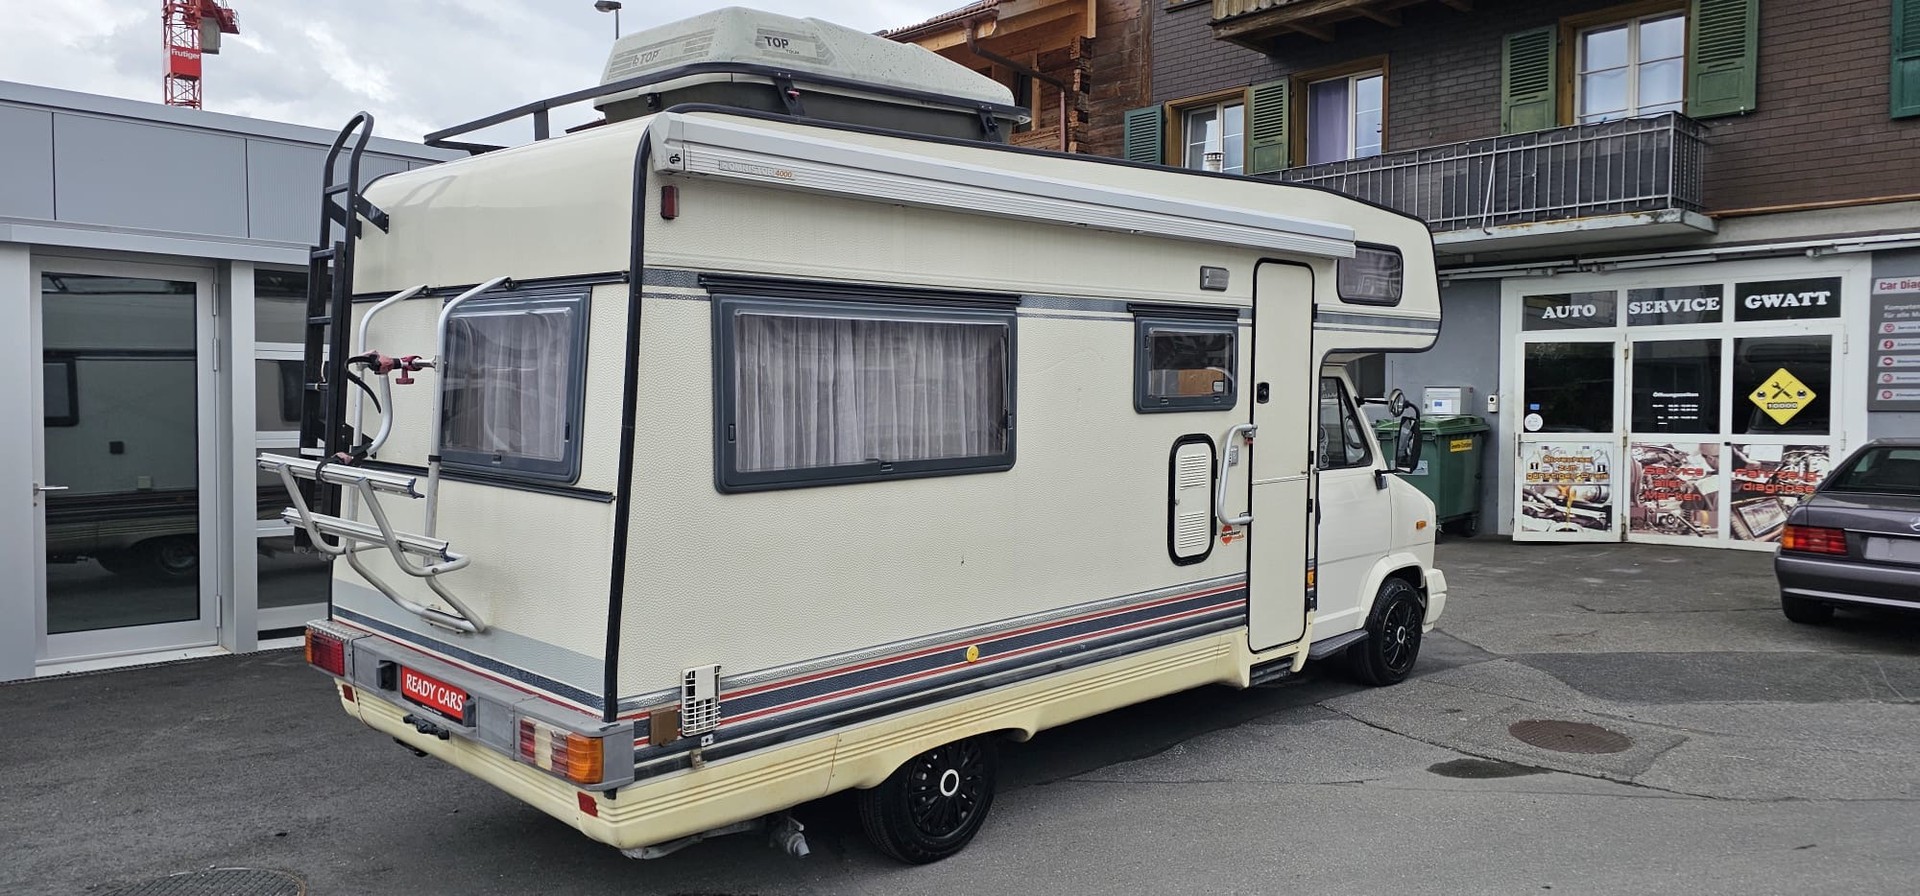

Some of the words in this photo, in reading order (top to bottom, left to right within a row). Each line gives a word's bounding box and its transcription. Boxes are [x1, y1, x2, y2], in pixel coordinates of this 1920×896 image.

[764, 36, 789, 49] TOP
[171, 49, 200, 60] Frutiger
[775, 169, 792, 178] 4000
[1880, 282, 1897, 290] Car
[1541, 304, 1597, 319] AUTO
[1628, 297, 1720, 315] SERVICE
[1744, 291, 1831, 309] GWATT
[1644, 465, 1705, 477] Service
[1653, 479, 1684, 488] aller
[1742, 483, 1815, 494] diagnose
[1644, 492, 1701, 501] Marken
[406, 673, 437, 700] READY
[437, 687, 463, 712] CARS
